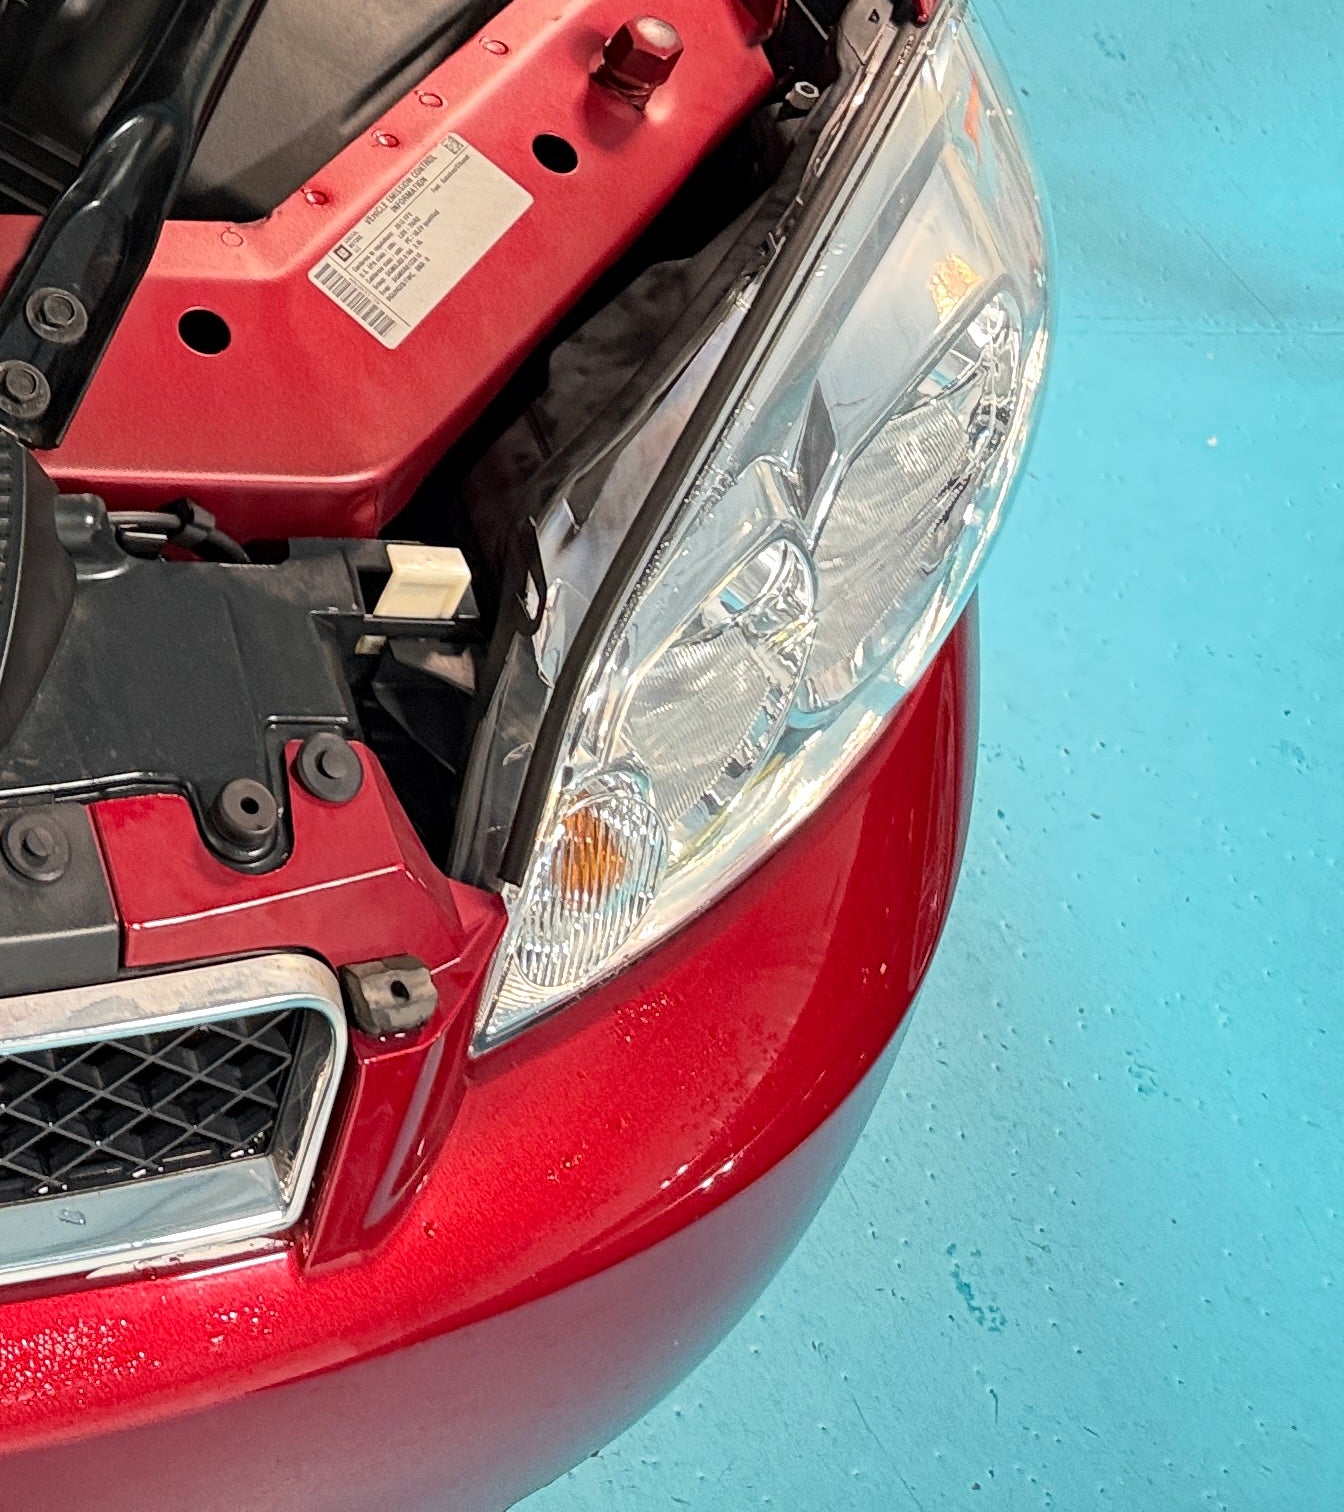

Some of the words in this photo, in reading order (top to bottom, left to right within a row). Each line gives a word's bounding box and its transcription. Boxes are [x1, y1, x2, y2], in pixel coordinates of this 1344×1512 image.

[363, 201, 388, 225] VEHICLE
[384, 175, 413, 203] EMISSION
[409, 152, 437, 179] CONTROL
[389, 174, 428, 213] INFORMATION
